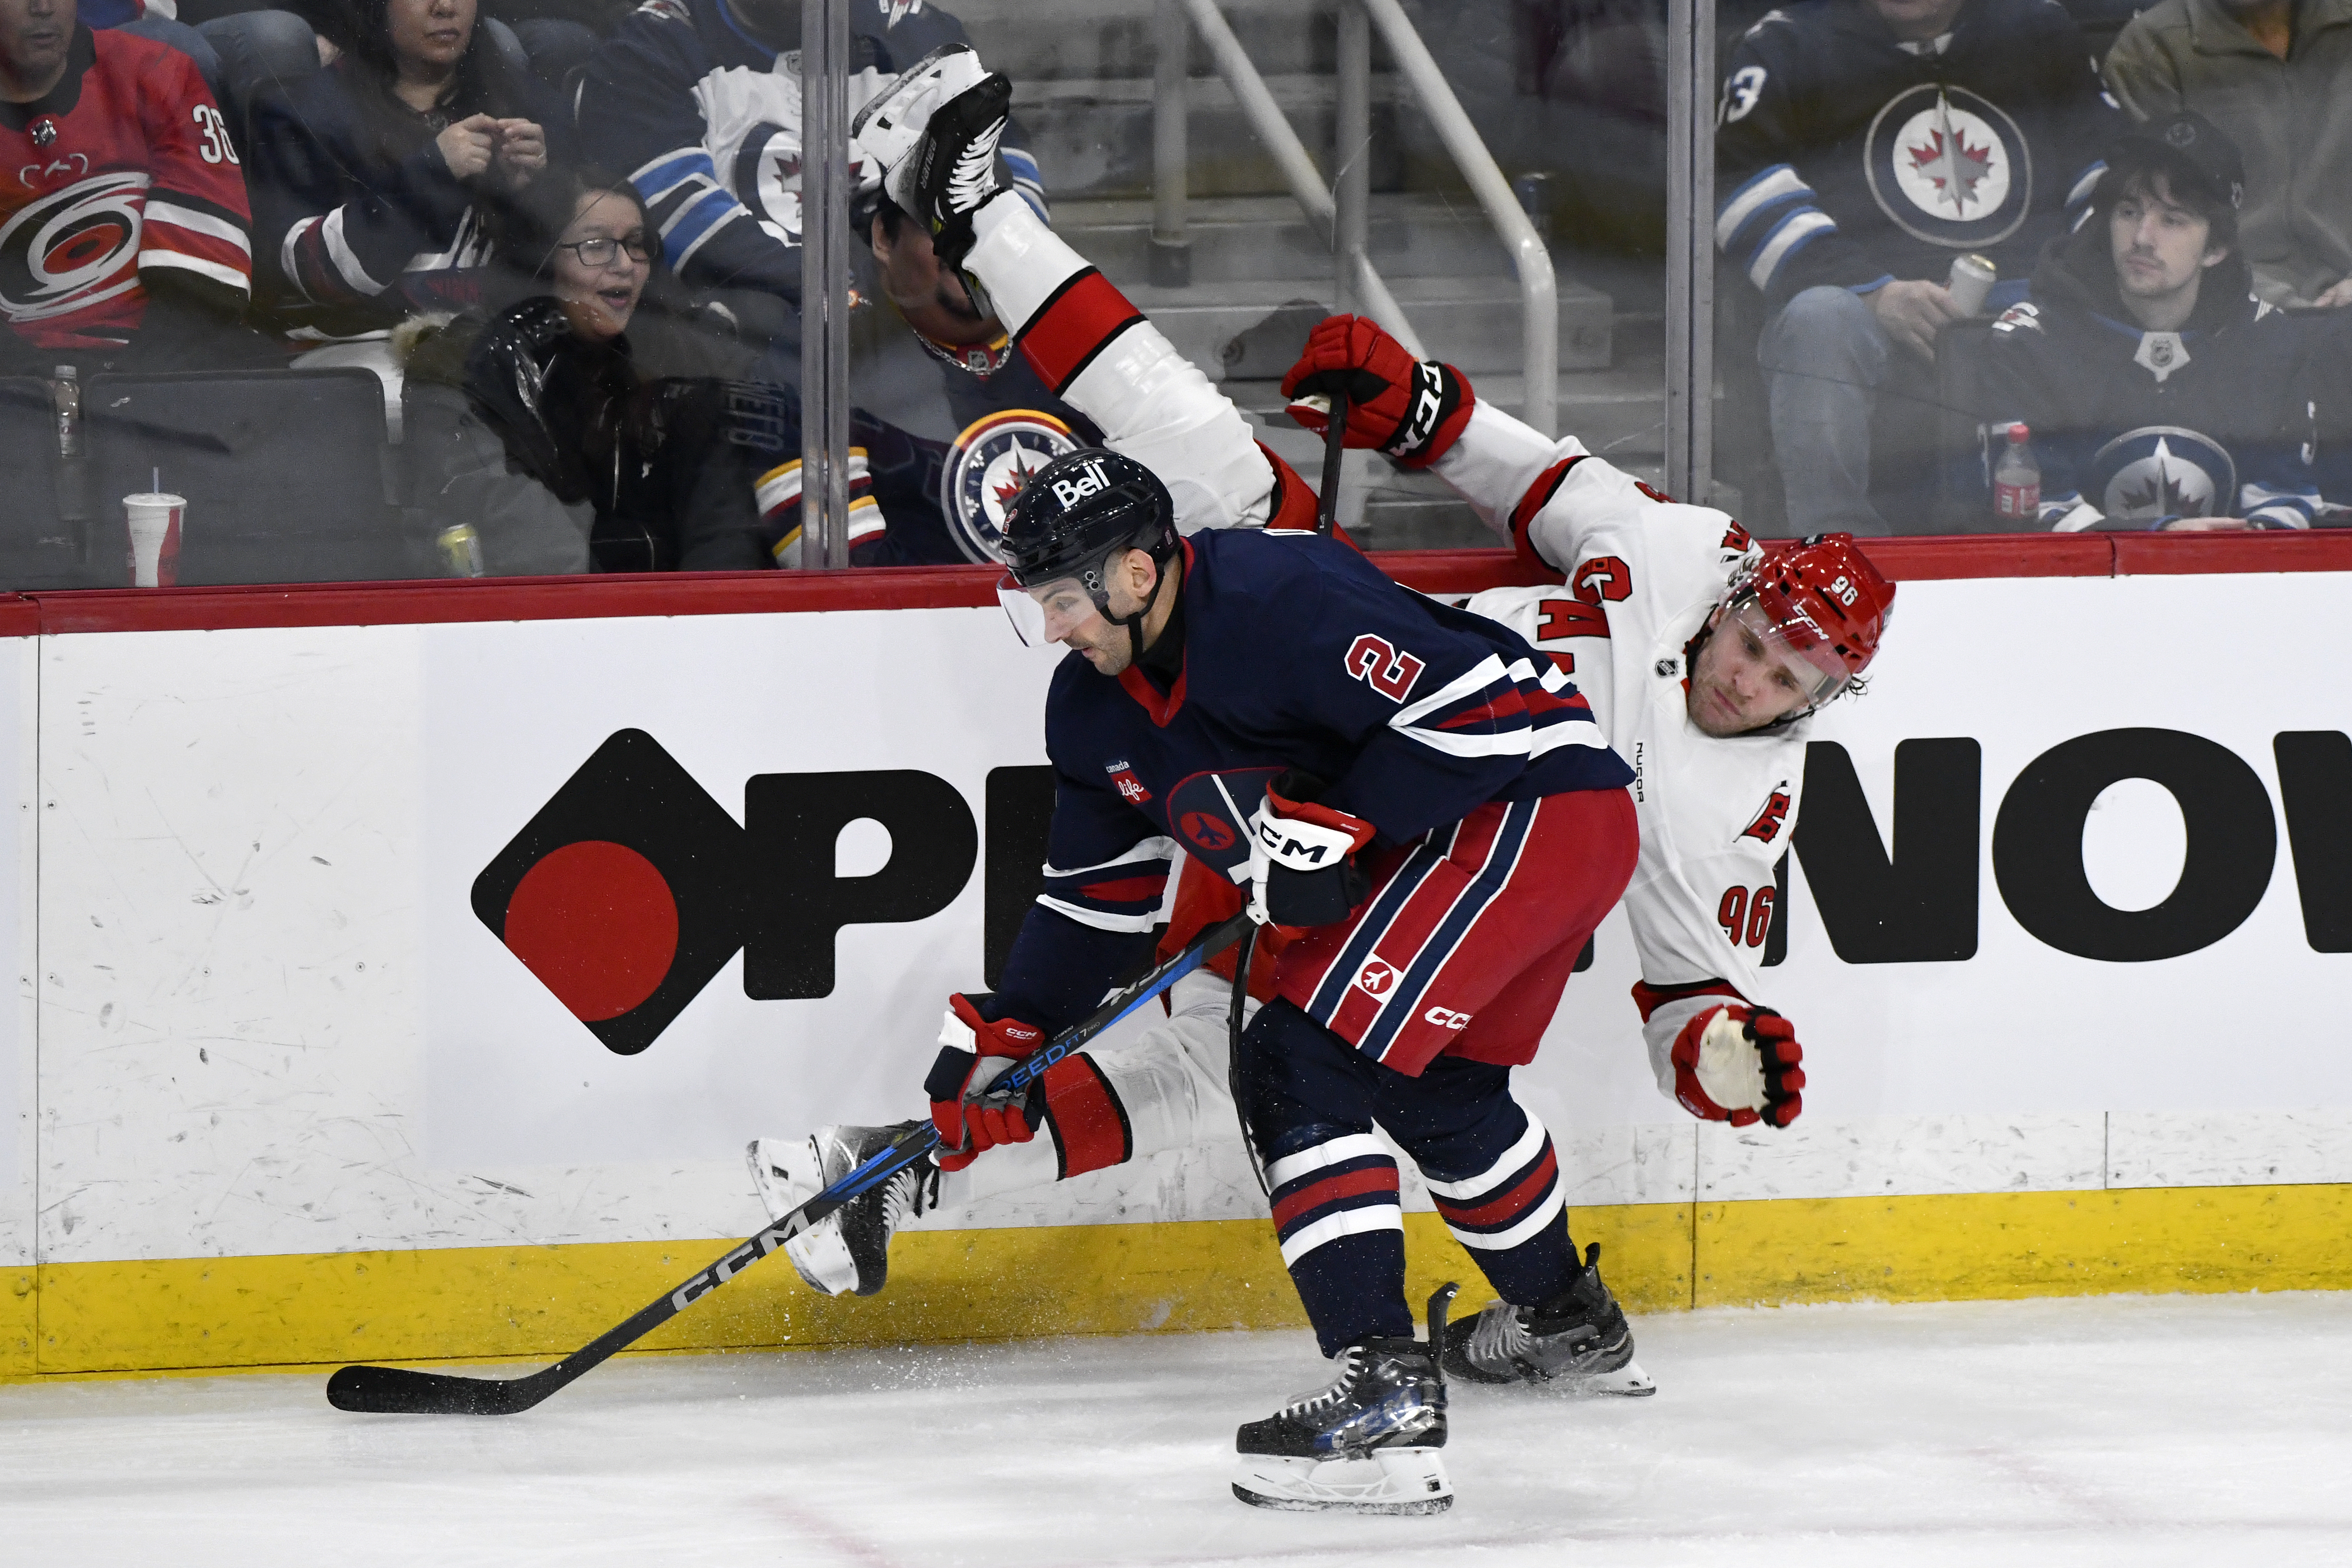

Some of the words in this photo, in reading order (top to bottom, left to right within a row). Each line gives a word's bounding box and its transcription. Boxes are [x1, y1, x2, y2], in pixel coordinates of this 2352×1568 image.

[1052, 463, 1111, 508] Bell
[1831, 575, 1859, 606] 96
[1344, 633, 1426, 704] 2
[1105, 760, 1130, 773] canada
[1636, 742, 1644, 803] NUCOR
[1117, 778, 1145, 801] life
[1718, 885, 1776, 948] 96
[1005, 1028, 1037, 1038] CCM
[1424, 1006, 1474, 1032] CC
[671, 1207, 810, 1312] CCM
